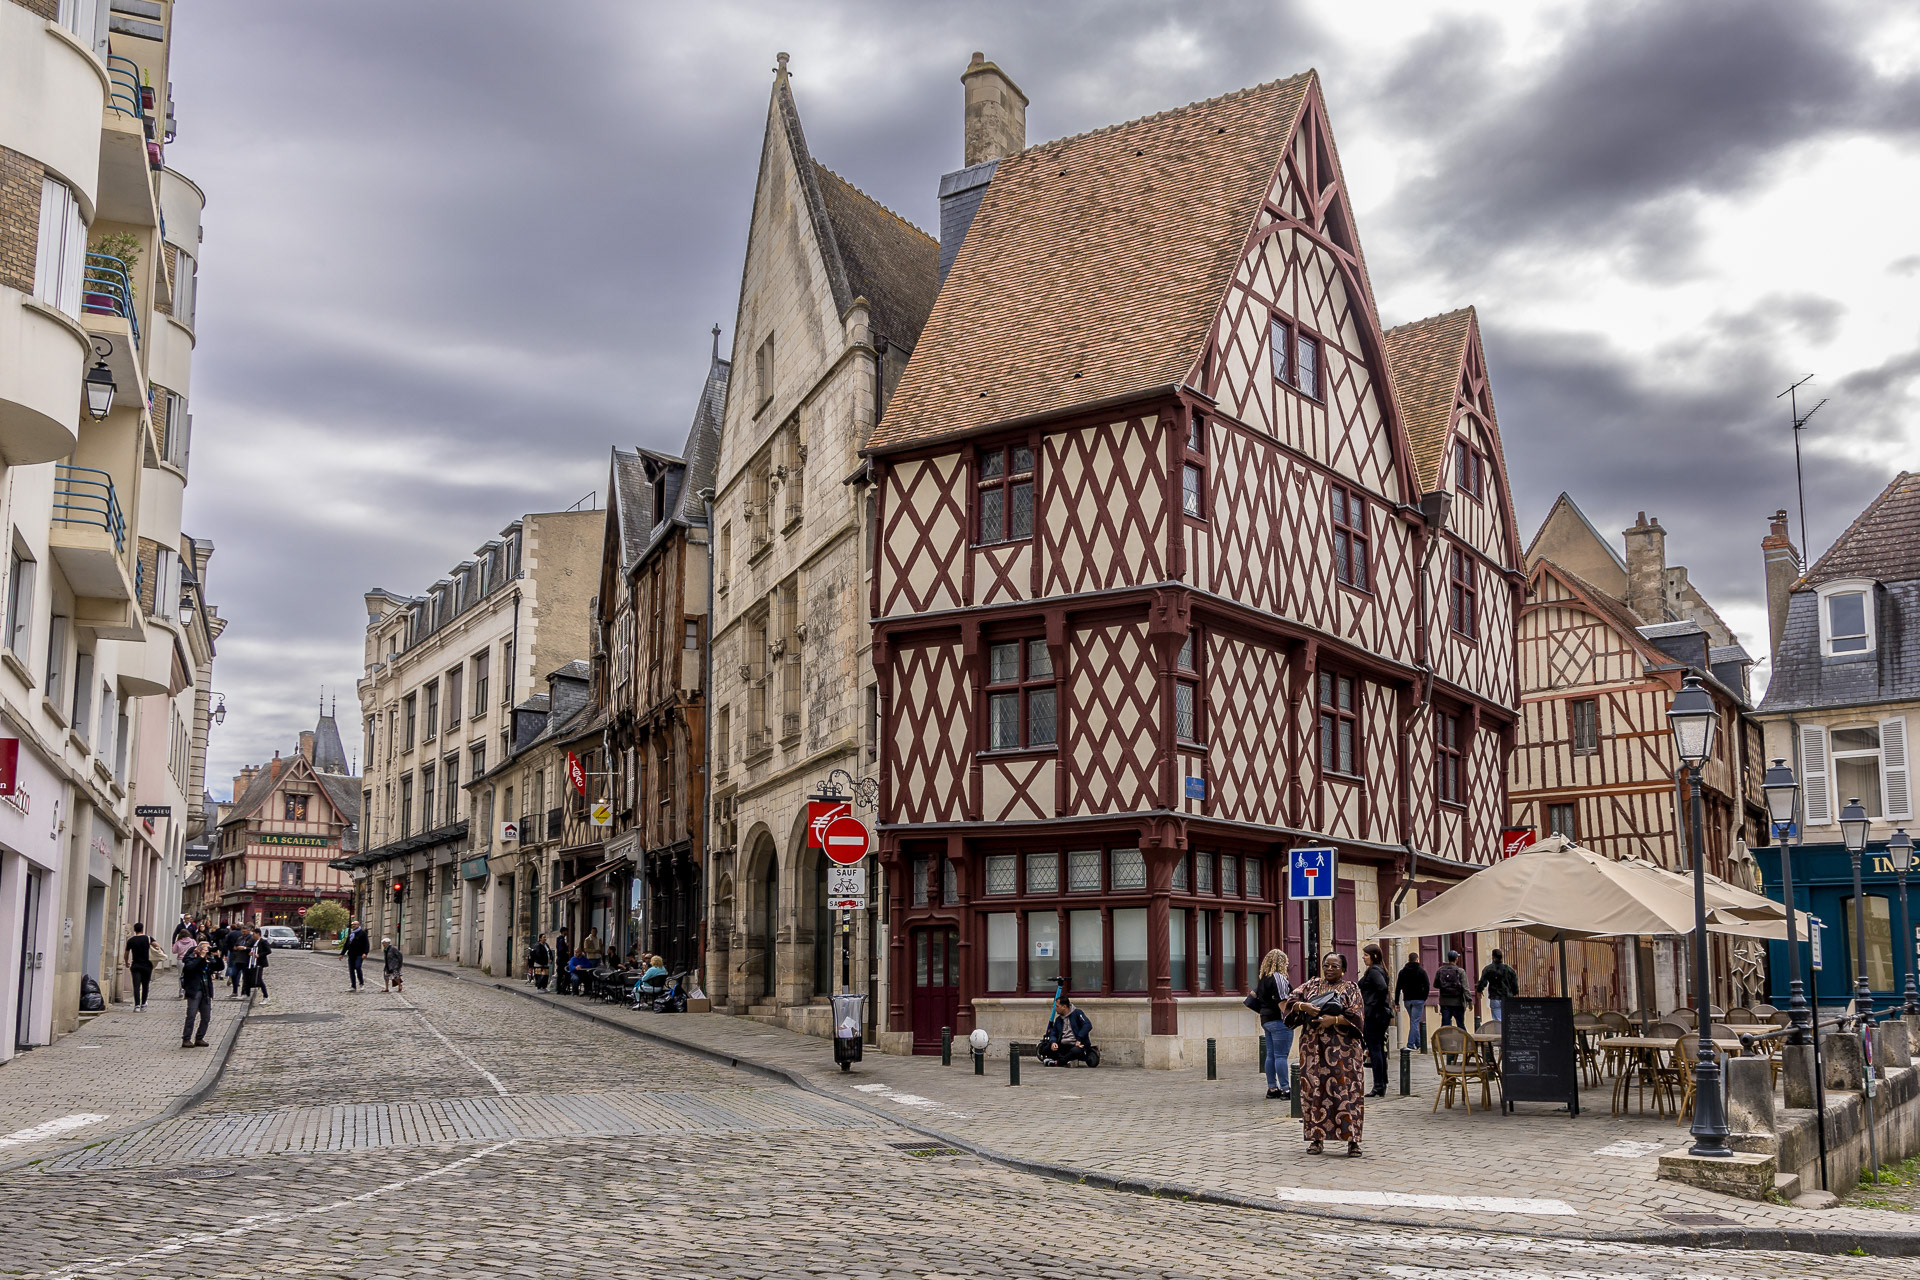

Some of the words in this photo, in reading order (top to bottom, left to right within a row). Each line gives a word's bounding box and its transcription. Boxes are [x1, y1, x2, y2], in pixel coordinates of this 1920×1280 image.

[570, 760, 584, 787] TABAC
[137, 807, 171, 815] CAMAÏEU
[280, 836, 322, 846] SCALETA
